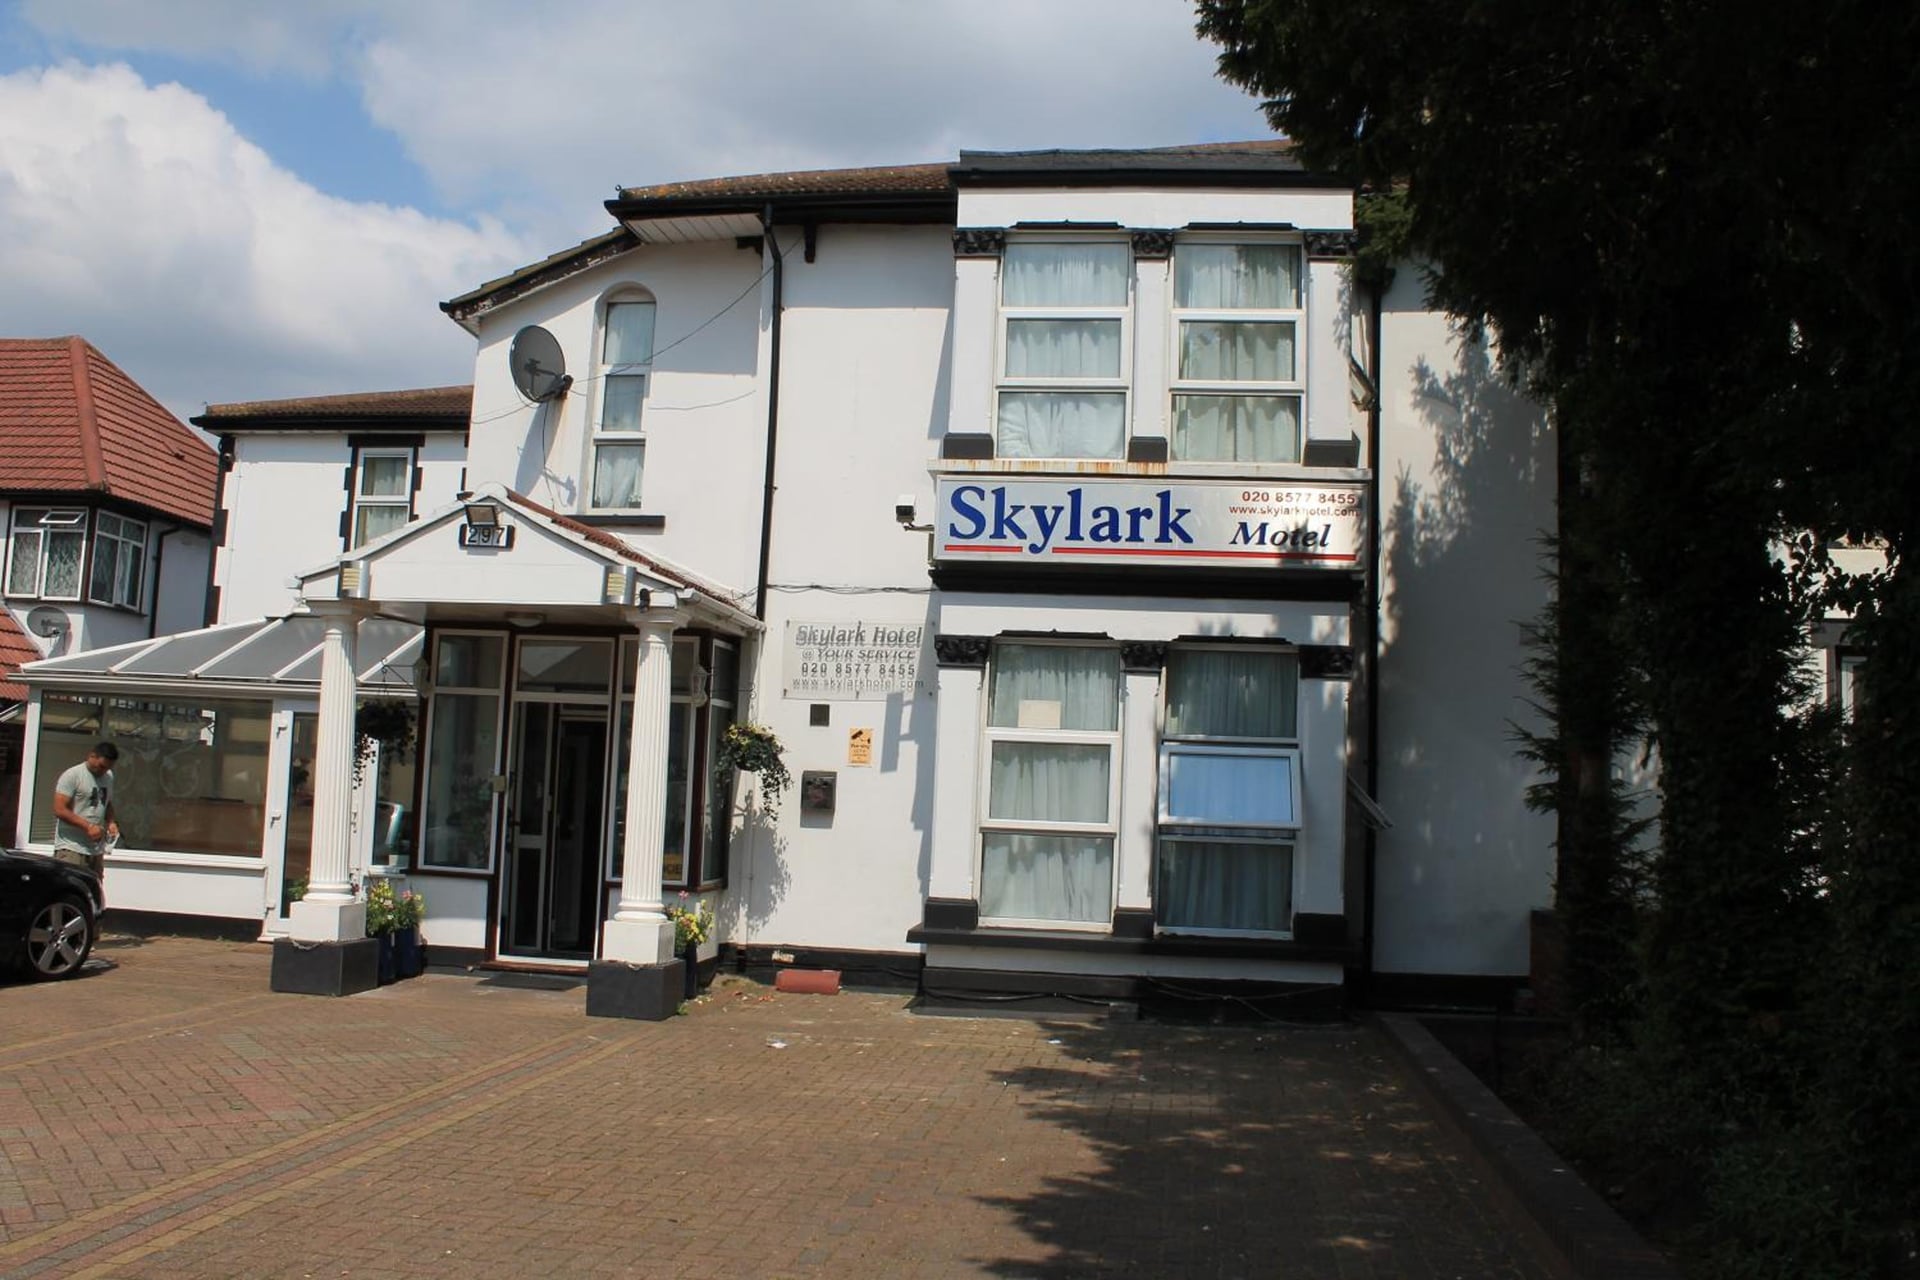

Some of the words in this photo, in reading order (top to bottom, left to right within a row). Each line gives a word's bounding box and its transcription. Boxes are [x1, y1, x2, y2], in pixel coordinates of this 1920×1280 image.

[1242, 491, 1270, 502] 020
[1275, 492, 1312, 503] 8577
[1318, 493, 1356, 504] 8455
[949, 485, 1194, 554] Skylark
[467, 526, 506, 544] 297
[1229, 521, 1332, 547] Motel
[796, 625, 866, 646] Skylark
[872, 626, 923, 644] Hotel
[817, 648, 854, 659] YOUR
[857, 649, 917, 660] SERVICE
[801, 662, 828, 674] 020
[835, 662, 871, 675] 8577
[879, 664, 915, 676] 8455
